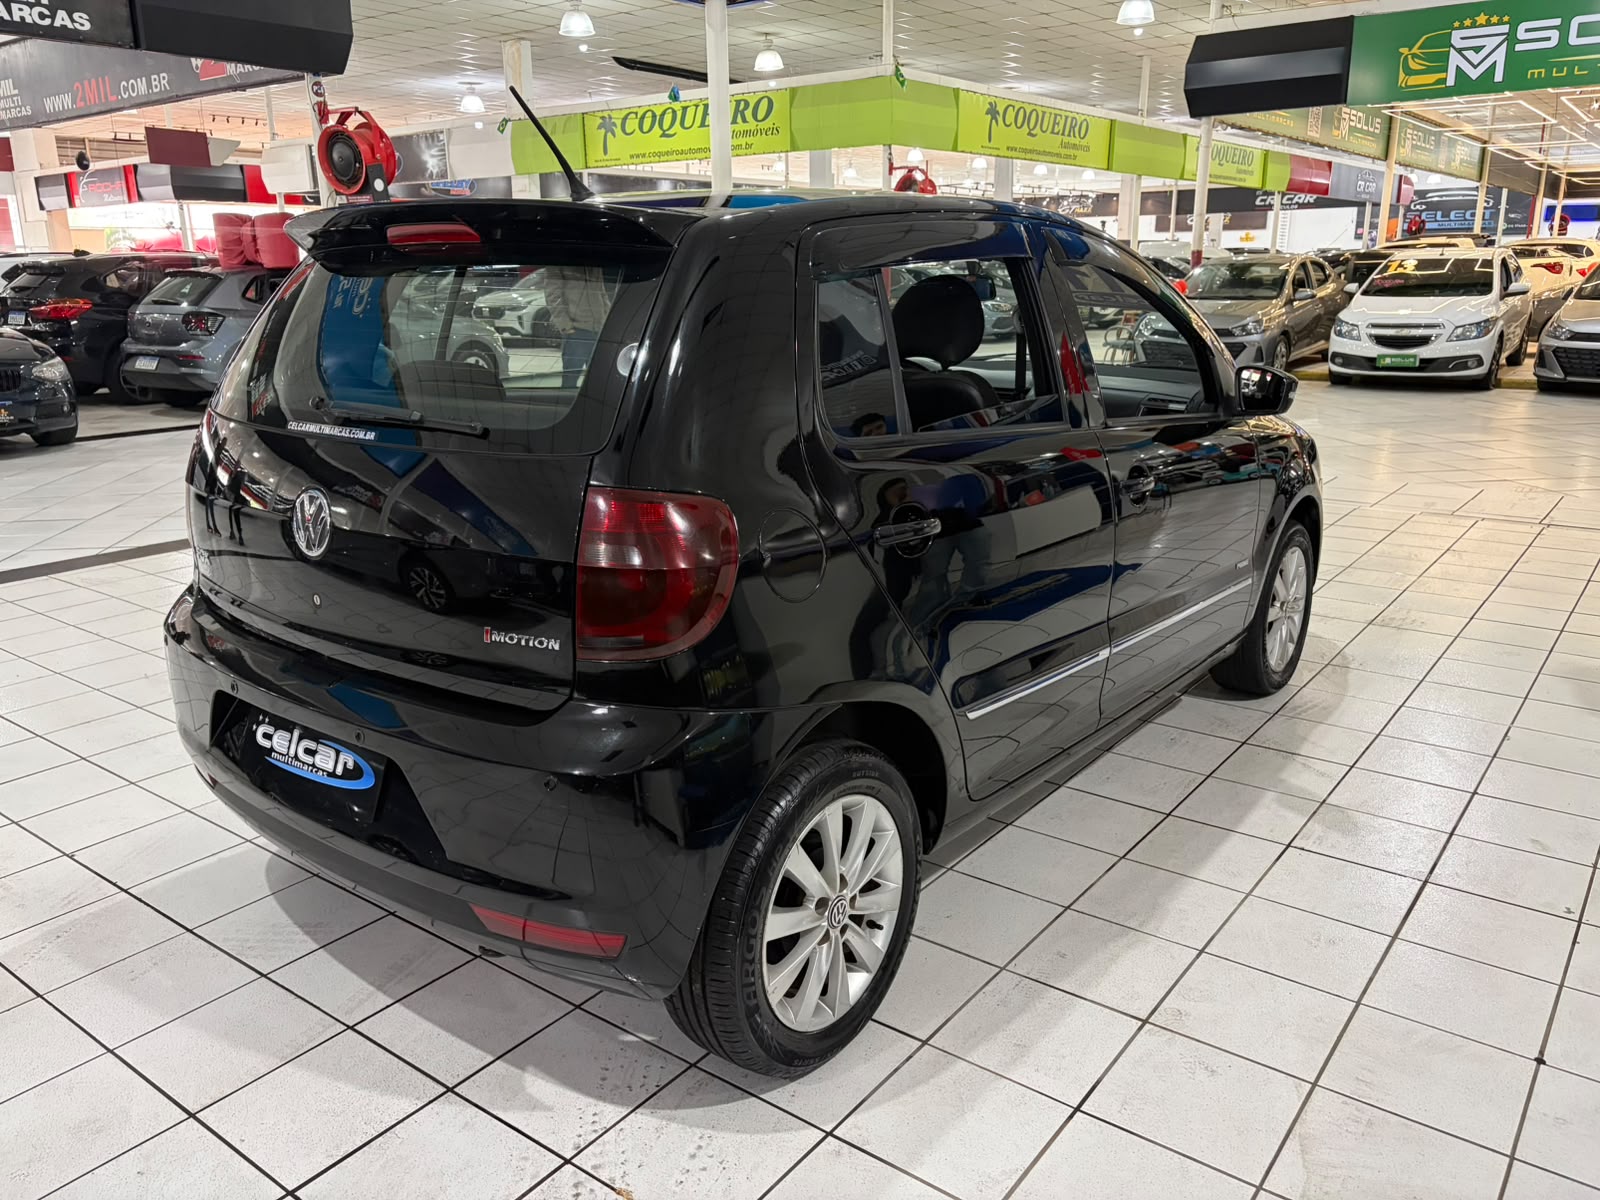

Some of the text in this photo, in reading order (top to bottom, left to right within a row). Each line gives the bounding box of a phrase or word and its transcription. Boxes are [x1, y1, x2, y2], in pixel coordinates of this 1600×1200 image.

[1527, 63, 1600, 80] MUL
[620, 95, 775, 139] COQUERO
[1002, 104, 1090, 140] COQUEIRO
[731, 122, 781, 140] tomóveis
[1211, 143, 1255, 168] OQUEIRO
[287, 421, 377, 441] CELCARMULTIMARCAS.COM.BR
[255, 723, 355, 776] celcar
[270, 751, 328, 778] multimarcas
